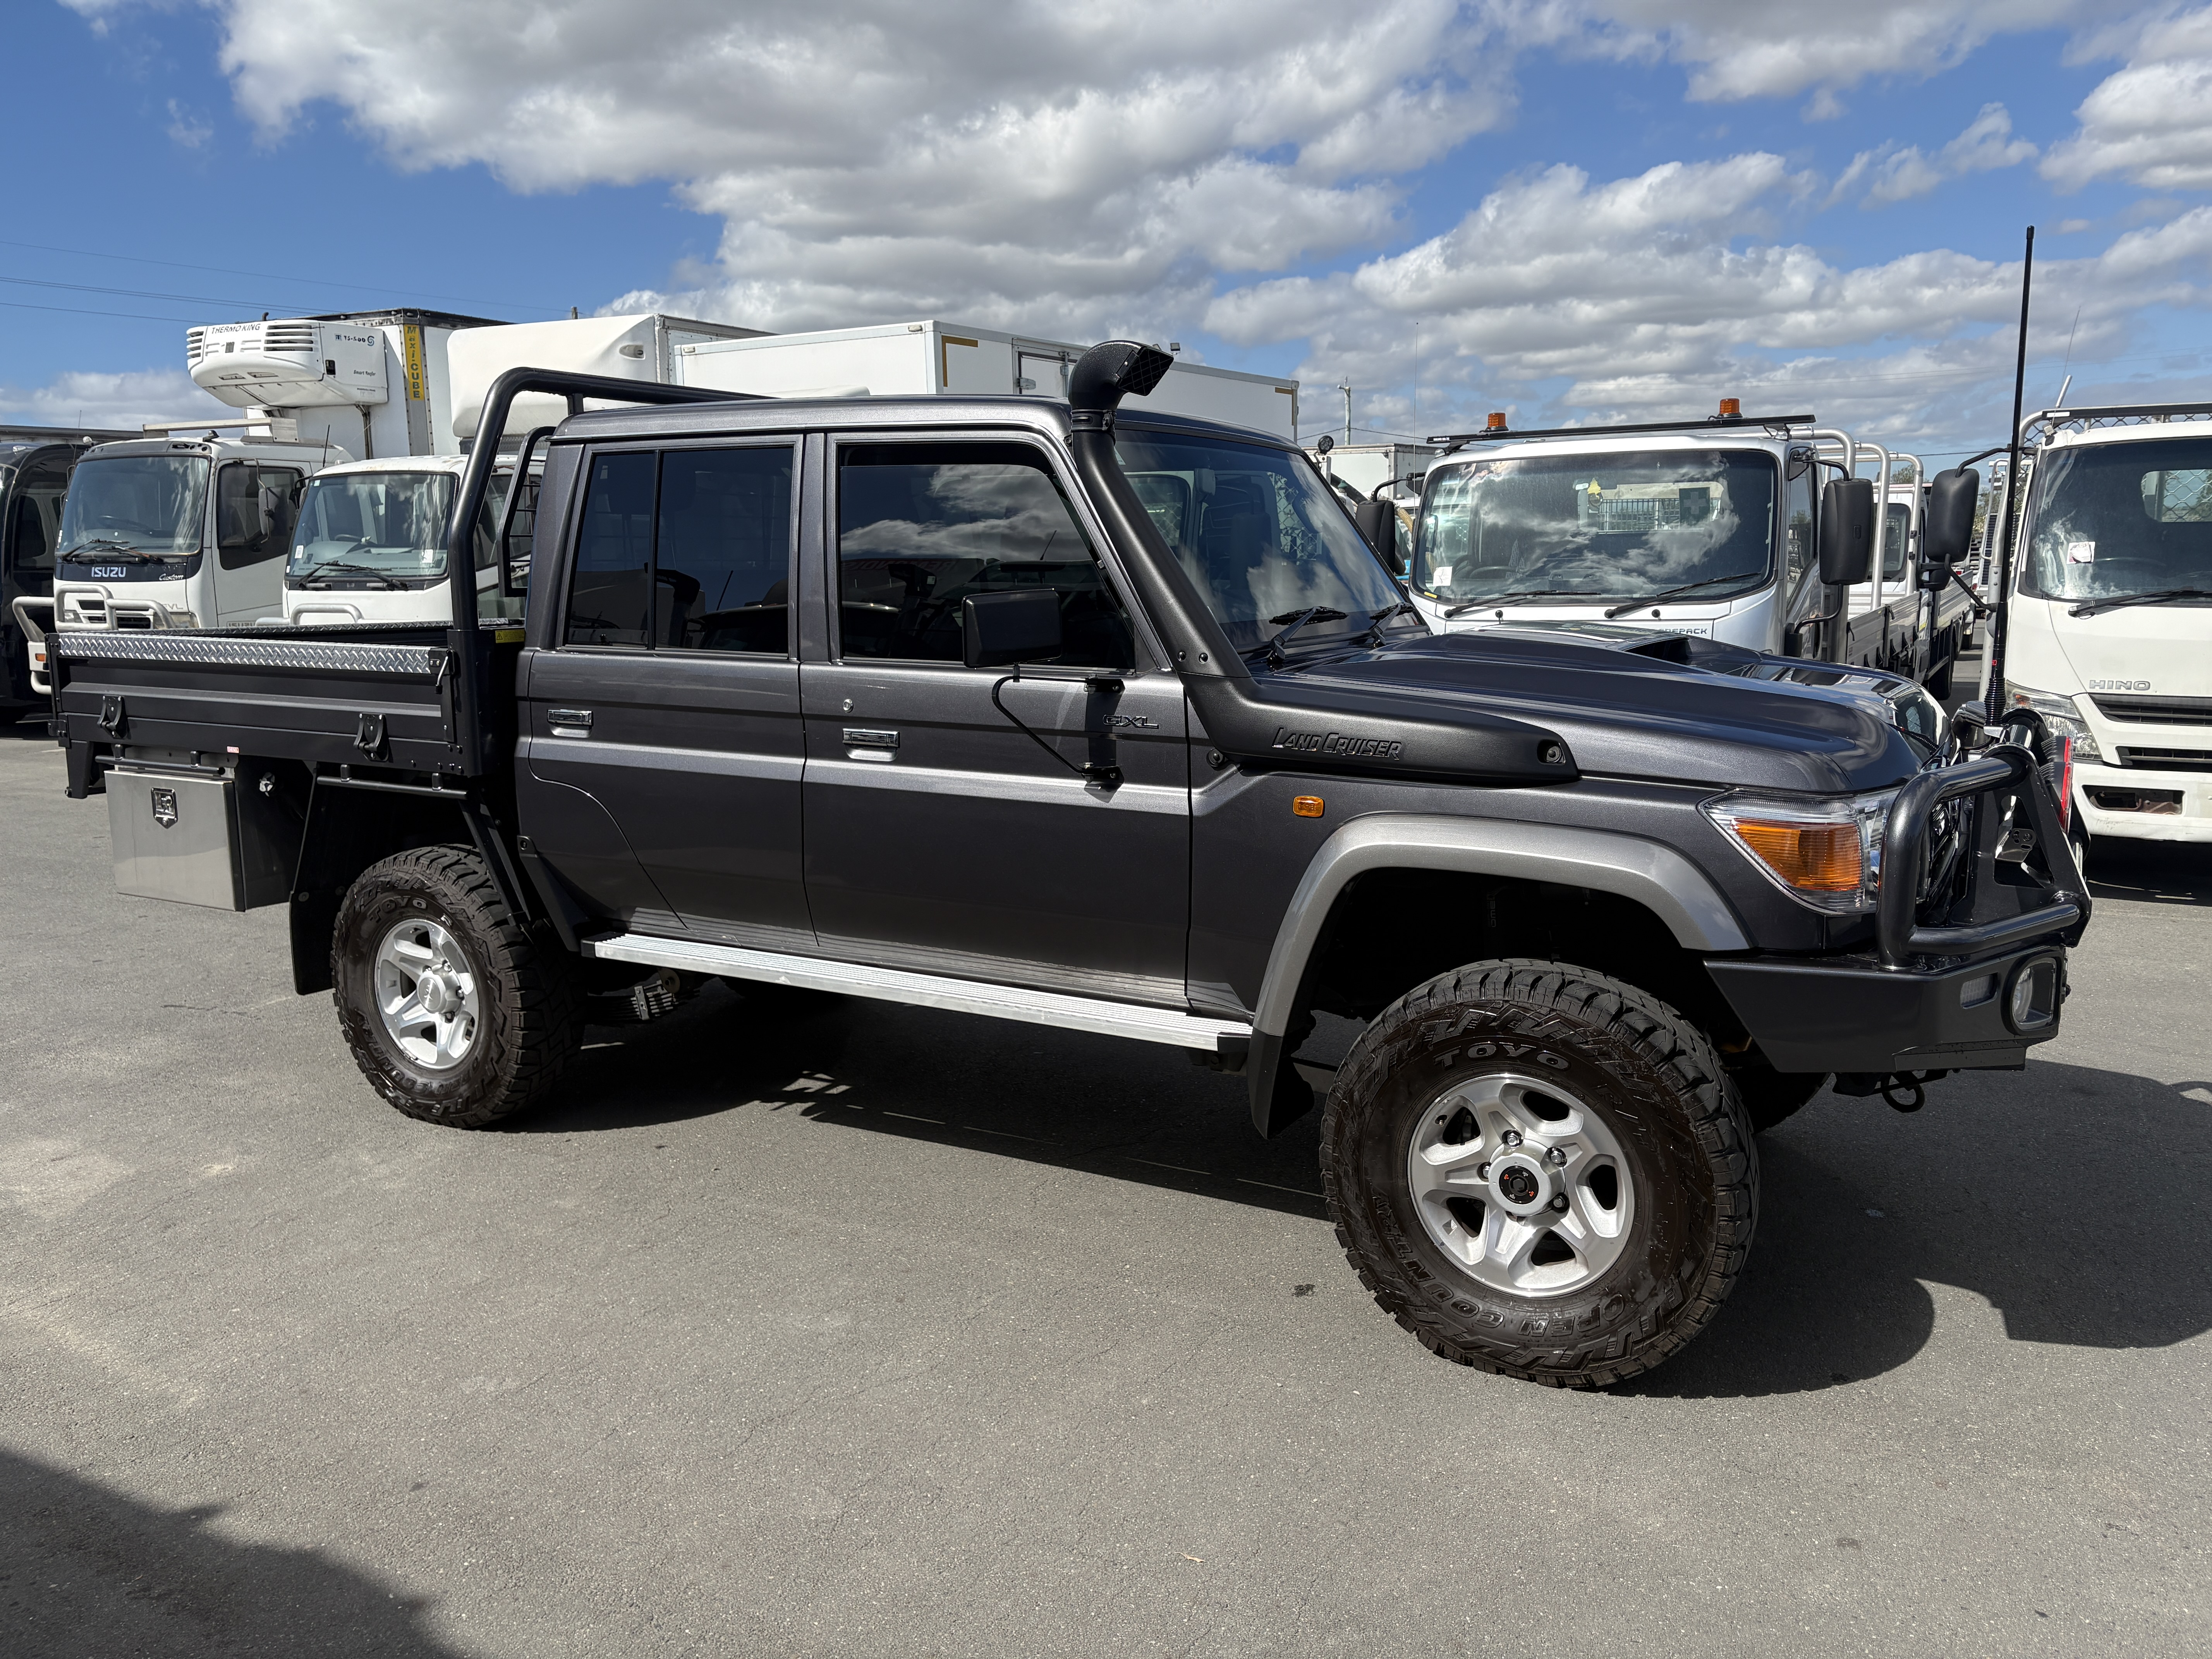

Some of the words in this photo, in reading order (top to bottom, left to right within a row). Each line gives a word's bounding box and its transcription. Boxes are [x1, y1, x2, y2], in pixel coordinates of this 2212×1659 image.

[212, 325, 241, 334] THERMO
[407, 326, 420, 398] Maxi-CUBE
[91, 567, 126, 577] ISUZU
[2089, 680, 2150, 691] HINO
[1103, 714, 1159, 729] GXL
[1272, 727, 1322, 751] LAND
[1322, 732, 1402, 760] CRUISER
[368, 895, 428, 923] TOYO
[1433, 1042, 1571, 1071] TOYO
[1372, 1196, 1504, 1328] COUNTRY
[1517, 1293, 1624, 1337] OPEN
